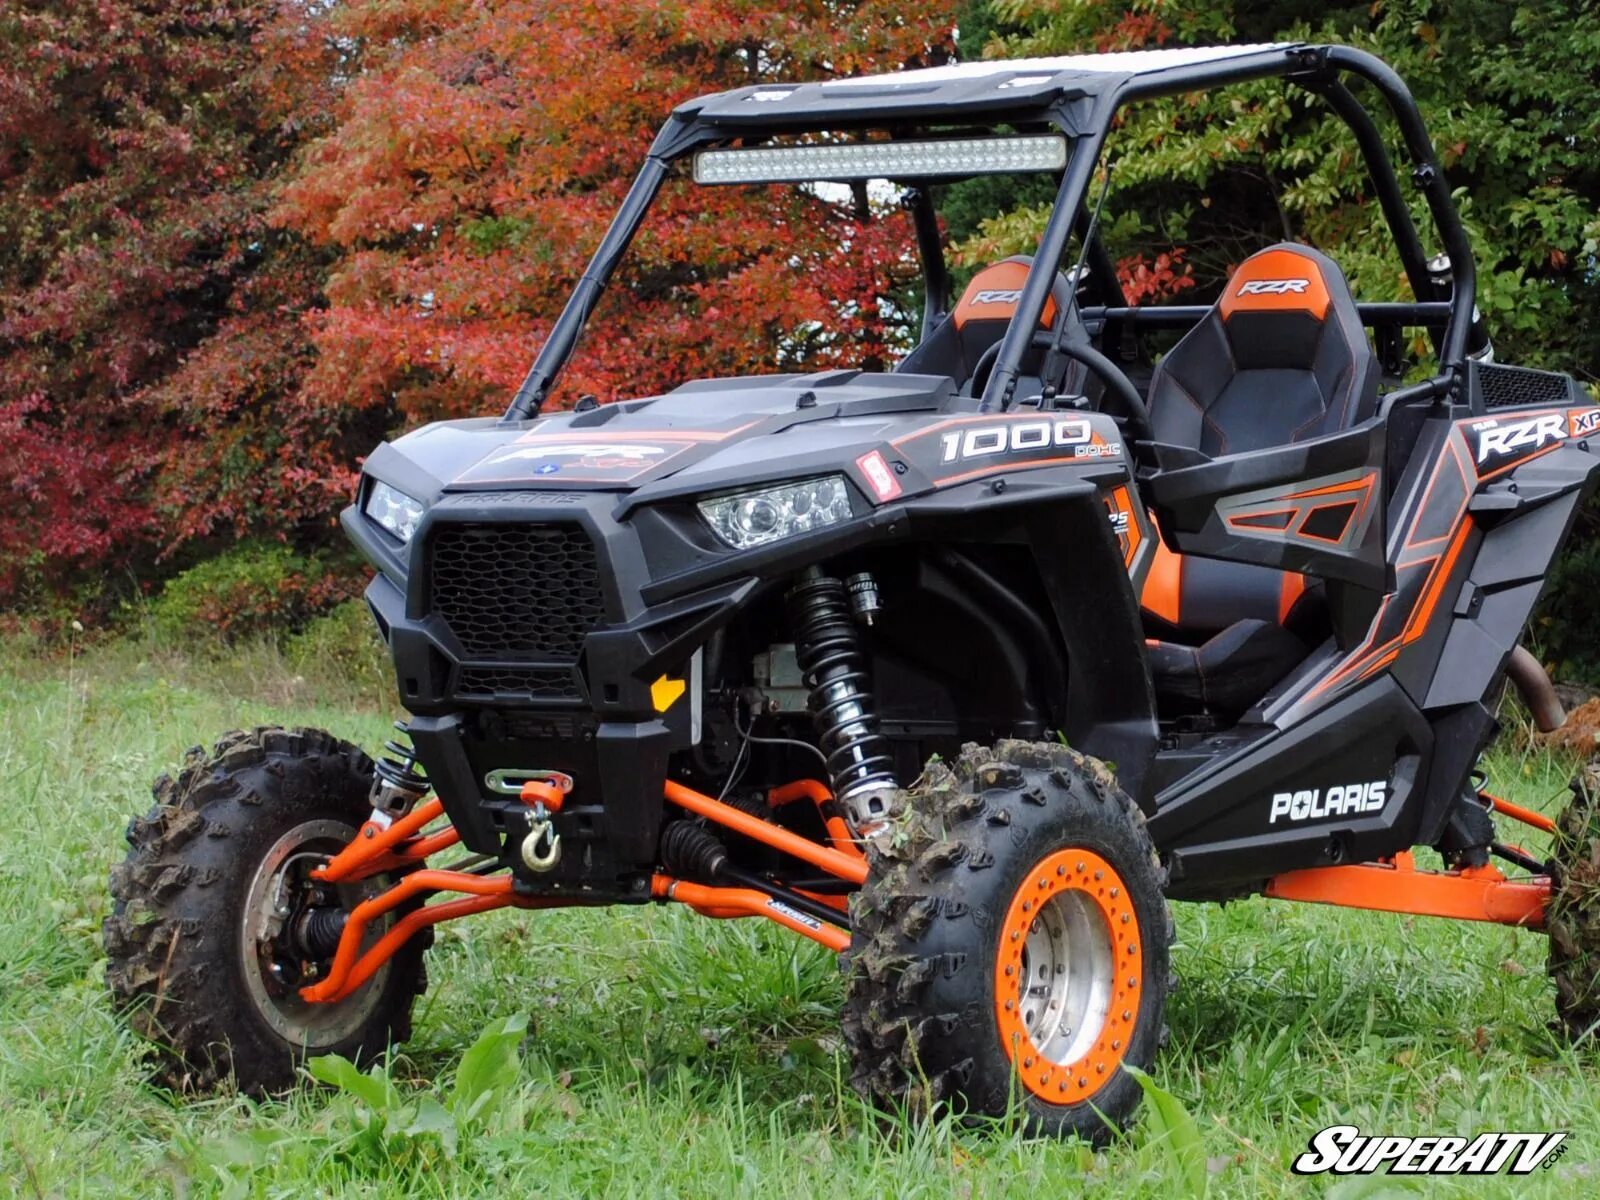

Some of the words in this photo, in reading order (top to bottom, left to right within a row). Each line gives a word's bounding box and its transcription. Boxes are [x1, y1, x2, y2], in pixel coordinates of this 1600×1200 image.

[1237, 279, 1311, 297] RZR
[941, 420, 1091, 463] 1000
[1478, 415, 1569, 464] RZR
[1269, 781, 1387, 824] POLARIS
